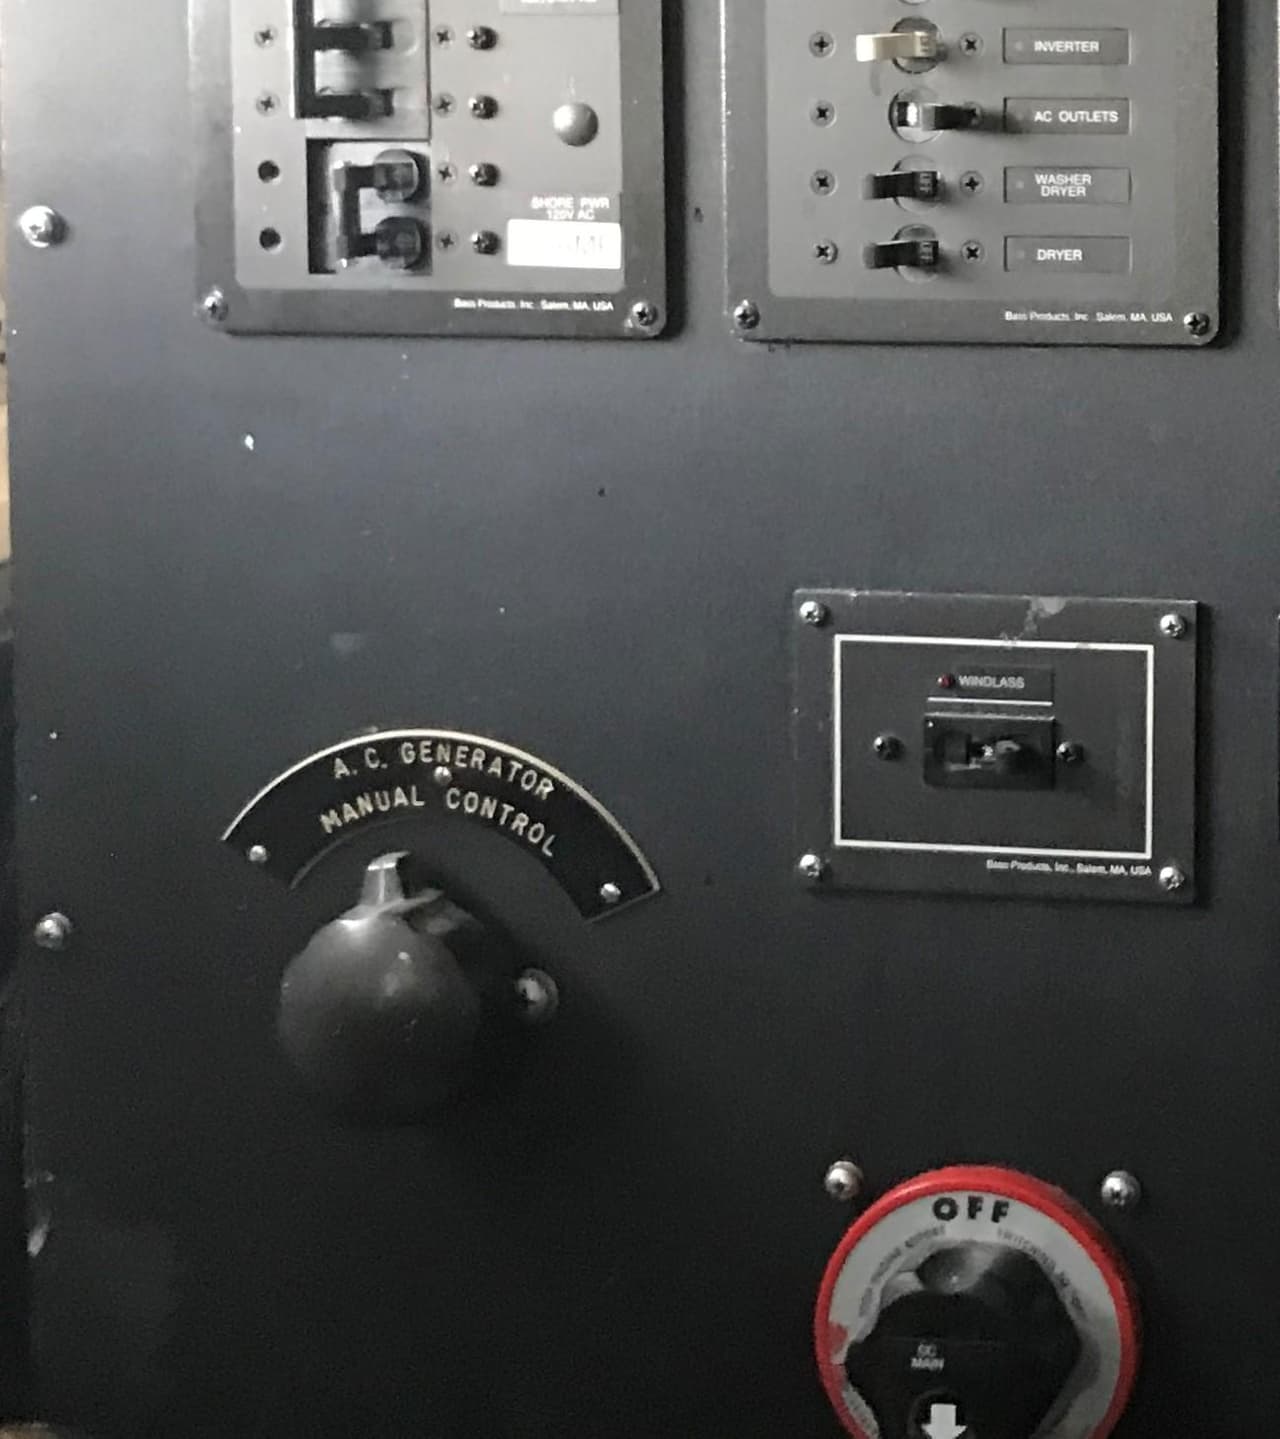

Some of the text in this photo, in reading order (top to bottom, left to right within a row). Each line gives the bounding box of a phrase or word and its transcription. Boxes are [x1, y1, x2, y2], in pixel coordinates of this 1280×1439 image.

[1035, 41, 1098, 52] INVERTER
[1035, 111, 1118, 123] AC OUTLETS
[1035, 174, 1091, 185] WASHER
[1041, 186, 1086, 197] DRYER
[1037, 249, 1082, 261] DRYER
[959, 675, 1024, 689] WINDLASS
[334, 740, 555, 801] A. C. GENERATOR
[320, 786, 555, 857] MANUAL CONTROL
[932, 1196, 1010, 1223] OFF
